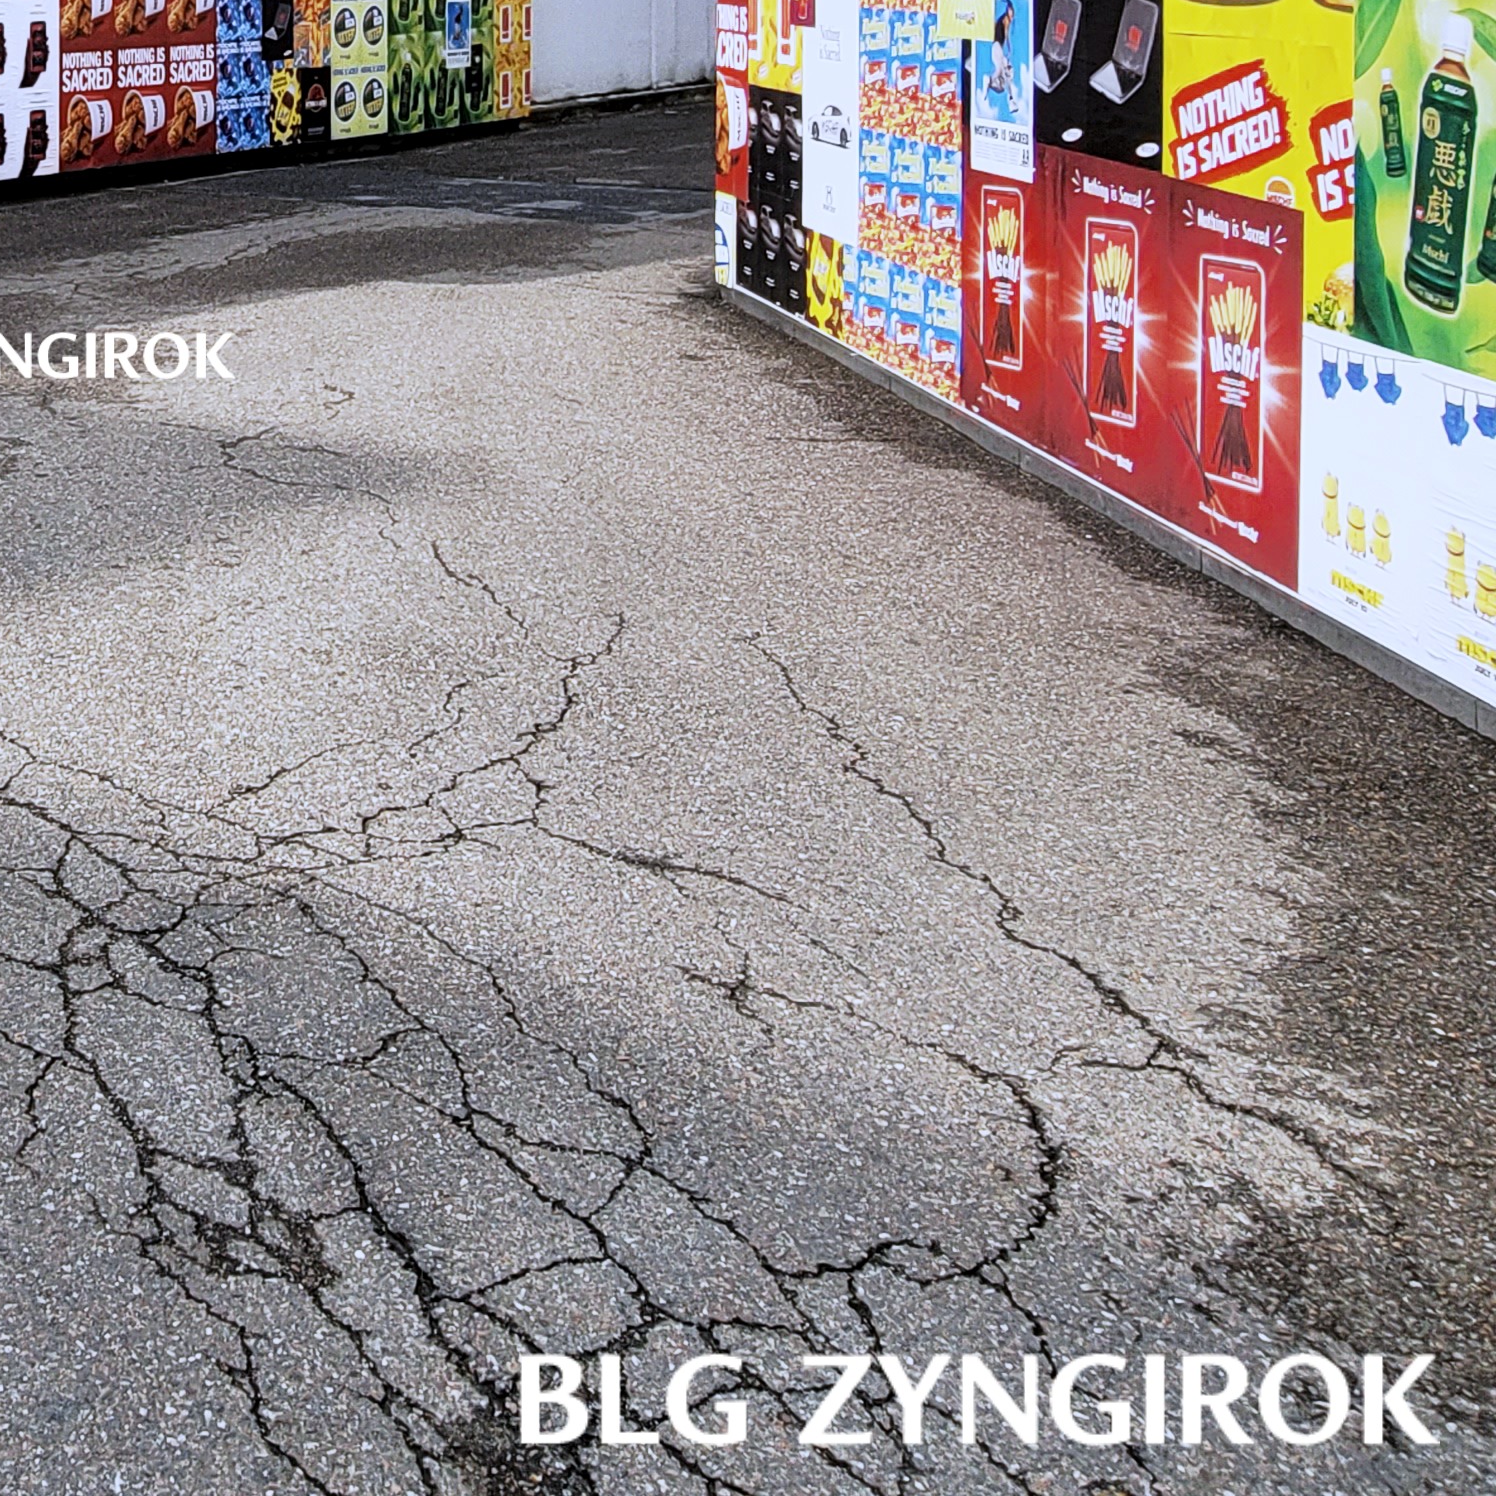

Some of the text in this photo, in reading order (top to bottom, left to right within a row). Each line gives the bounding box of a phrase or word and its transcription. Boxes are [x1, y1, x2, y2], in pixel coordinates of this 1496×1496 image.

[62, 50, 113, 70] NOTHING IS
[117, 47, 165, 65] NOTHING IS
[169, 43, 215, 62] NOTHING IS
[62, 67, 113, 93] SACRED
[117, 63, 166, 88] SACRED
[169, 60, 215, 84] SACRED
[1179, 71, 1265, 138] NOTHING
[1176, 142, 1196, 180] IS
[1200, 107, 1281, 172] SACRED!
[1317, 168, 1342, 212] IS
[1197, 206, 1270, 247] Nothing is Sacred
[1092, 290, 1133, 329] Mschf
[1208, 336, 1260, 382] Mschf
